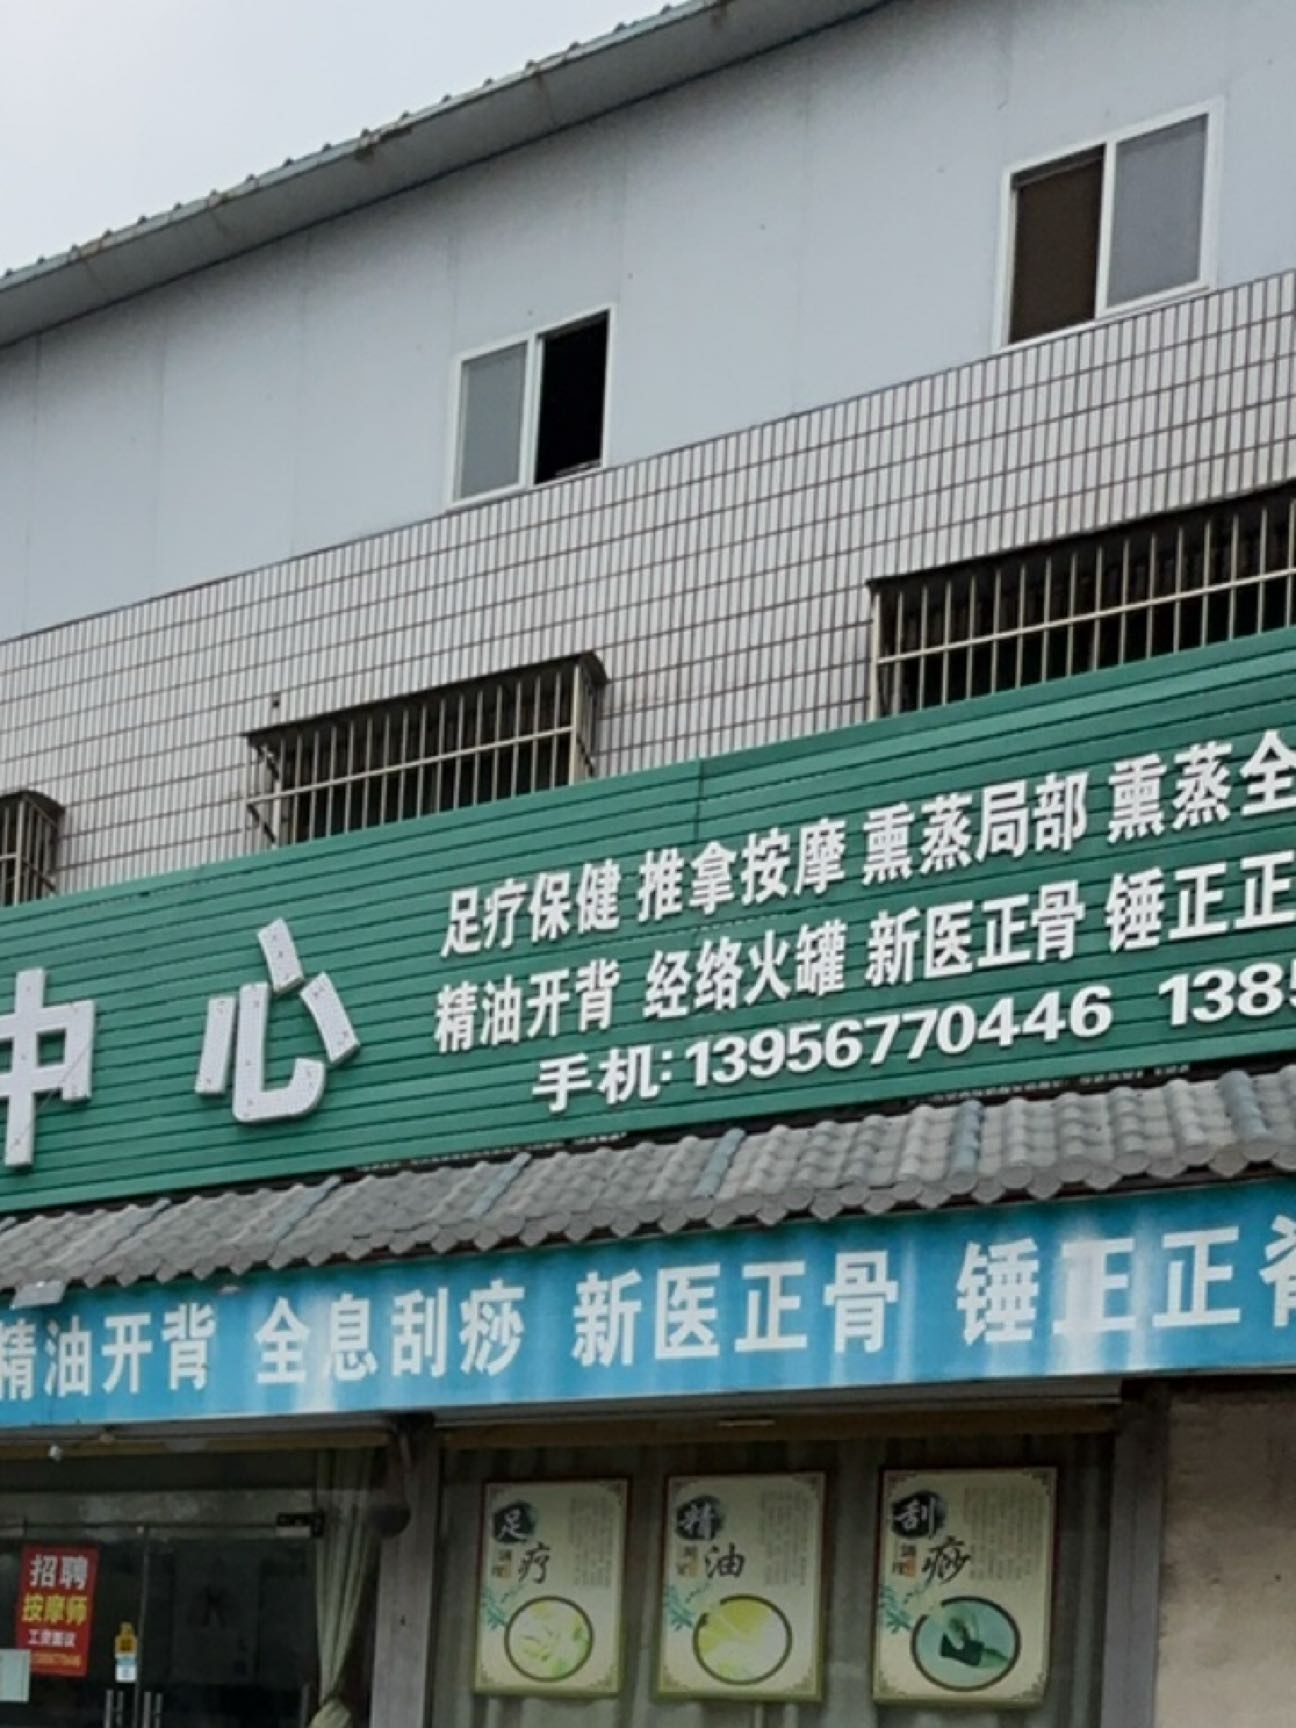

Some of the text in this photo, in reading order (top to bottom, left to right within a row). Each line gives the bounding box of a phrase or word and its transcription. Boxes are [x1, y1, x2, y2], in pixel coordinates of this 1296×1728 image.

[440, 857, 621, 958] 足疗保健
[637, 818, 847, 923] 推拿按摩
[862, 770, 1089, 881] 熏蒸局部
[433, 849, 1296, 1054] 精油开背 经络火罐 新医正骨 锤正正
[1158, 960, 1296, 1027] 138
[254, 1278, 527, 1384] 全息刮痧
[572, 1250, 900, 1368] 新医正骨
[21, 1592, 89, 1626] 按摩师
[29, 1553, 90, 1591] 招聘
